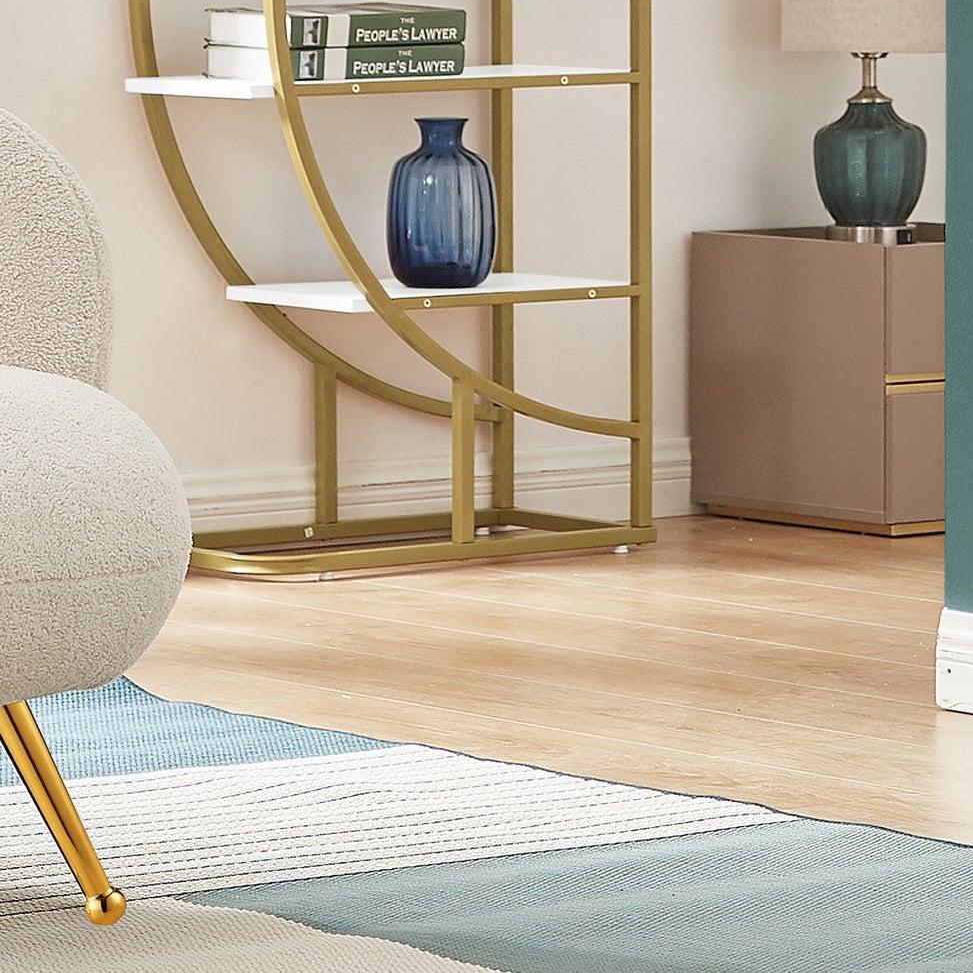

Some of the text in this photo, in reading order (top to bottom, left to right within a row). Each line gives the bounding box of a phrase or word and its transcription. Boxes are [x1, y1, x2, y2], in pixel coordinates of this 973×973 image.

[355, 26, 457, 43] PEOPLE'S LAWYER
[398, 49, 413, 57] THE
[352, 59, 455, 76] PEOPLE'S LAWYER
